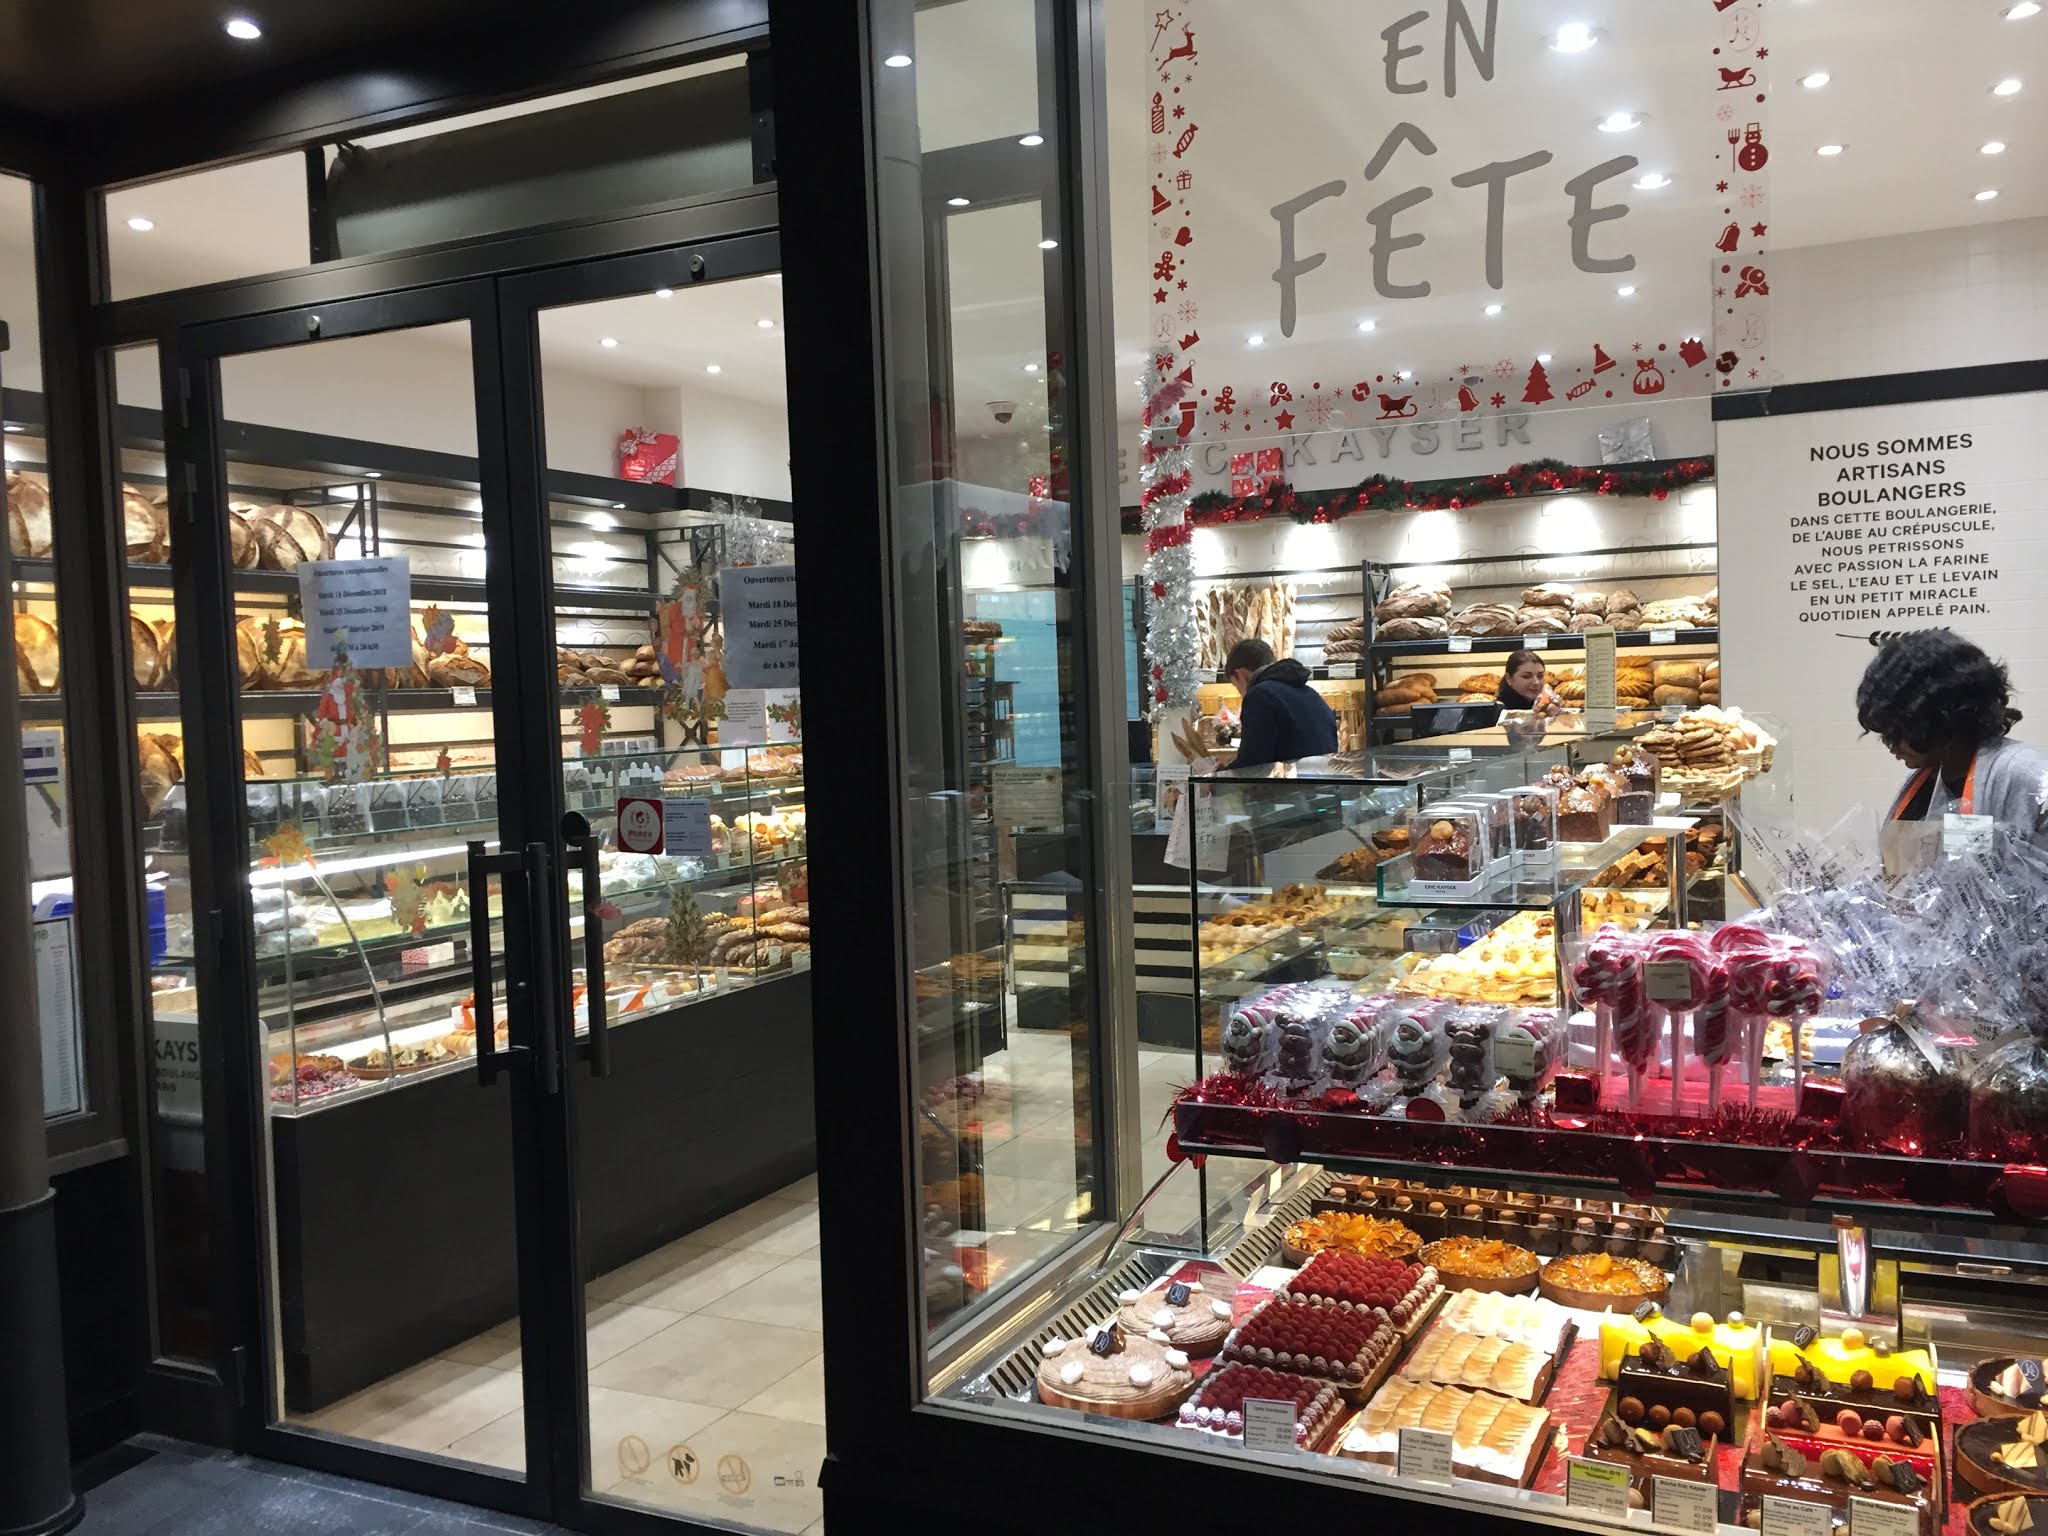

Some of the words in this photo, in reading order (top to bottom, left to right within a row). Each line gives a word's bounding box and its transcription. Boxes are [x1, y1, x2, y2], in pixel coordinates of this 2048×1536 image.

[1380, 0, 1498, 98] EN
[1269, 122, 1640, 338] FÊTE
[1285, 412, 1531, 467] KAYSER
[1810, 442, 1870, 462] NOUS
[1876, 433, 1974, 456] SOMMES
[1836, 459, 1946, 483] ARTISANS
[1818, 481, 1967, 507] BOULANGERS
[1790, 515, 1830, 528] DANS
[1833, 511, 1881, 524] CETTE
[1885, 503, 1997, 521] BOULANGERIE,
[1792, 532, 1811, 544] DE
[1815, 528, 1863, 542] L'AUBE
[1867, 527, 1888, 539] AU
[1892, 519, 1996, 537] CRÉPUSCULE,
[1821, 545, 1863, 557] NOUS
[1868, 538, 1965, 554] PETRISSONS
[1794, 562, 1833, 575] AVEC
[1837, 558, 1903, 572] PASSION
[1908, 557, 1928, 568] LA
[1933, 553, 1990, 567] FARINE
[743, 575, 785, 585] Ouvertures
[1790, 580, 1807, 591] LE
[1812, 578, 1844, 590] SEL,
[1848, 576, 1890, 588] L'EAU
[1895, 574, 1914, 585] ET
[1919, 572, 1937, 584] LE
[1942, 569, 1999, 583] LEVAIN
[748, 600, 771, 609] Mardi
[772, 601, 782, 609] 18
[1810, 595, 1830, 606] EN
[1834, 593, 1856, 605] UN
[1861, 590, 1904, 603] PETIT
[1909, 587, 1978, 601] MIRACLE
[1798, 608, 1881, 623] QUOTIDIEN
[1886, 602, 1944, 618] APPELÉ
[1949, 603, 1991, 616] PAIN.
[749, 620, 771, 629] Mardi
[773, 619, 782, 628] 25
[753, 641, 777, 649] Mardi
[762, 662, 771, 670] de
[785, 661, 796, 669] 30
